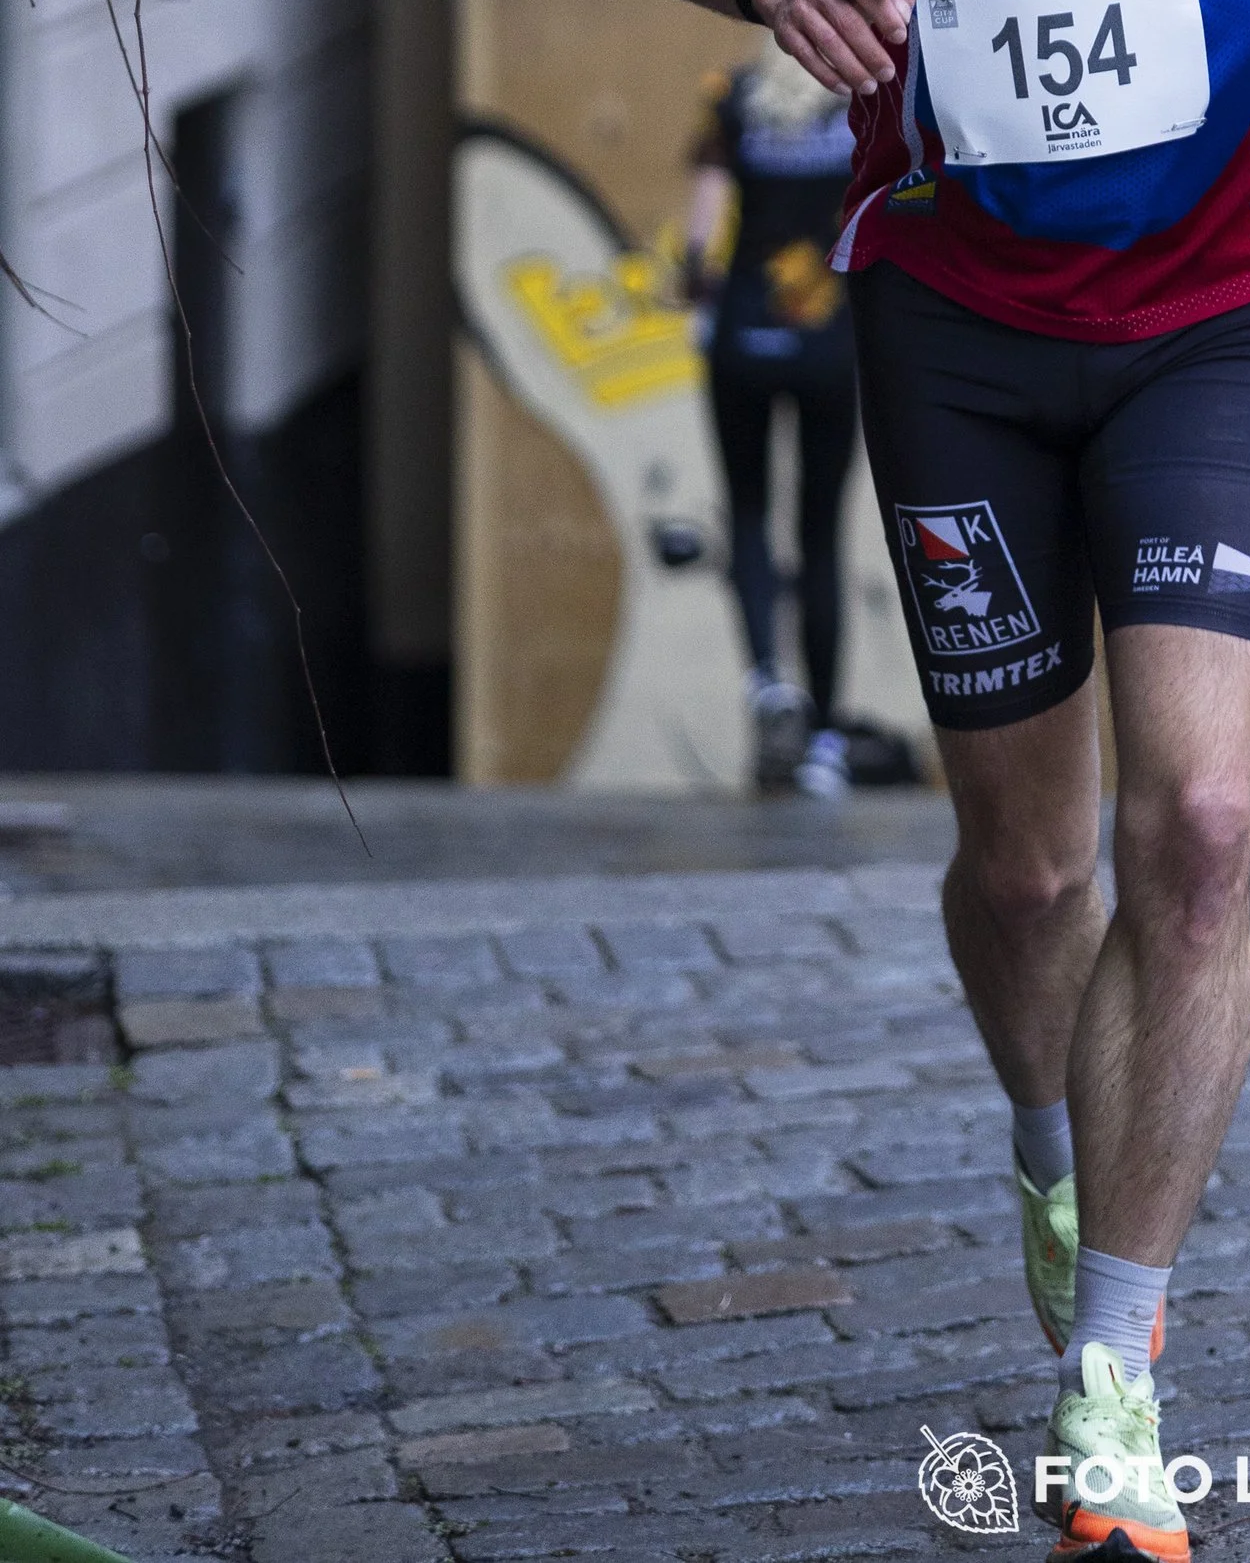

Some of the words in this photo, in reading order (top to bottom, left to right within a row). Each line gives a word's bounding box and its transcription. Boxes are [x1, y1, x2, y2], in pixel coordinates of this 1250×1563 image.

[933, 9, 953, 17] CITY
[991, 2, 1138, 100] 154
[1041, 100, 1098, 132] ICA
[1071, 127, 1101, 139] nära
[1047, 138, 1103, 154] Järvastaden
[1136, 544, 1204, 565] LULEÅ
[1132, 566, 1202, 585] HAMN
[930, 609, 1032, 649] RENEN
[929, 641, 1062, 696] TRIMTEX
